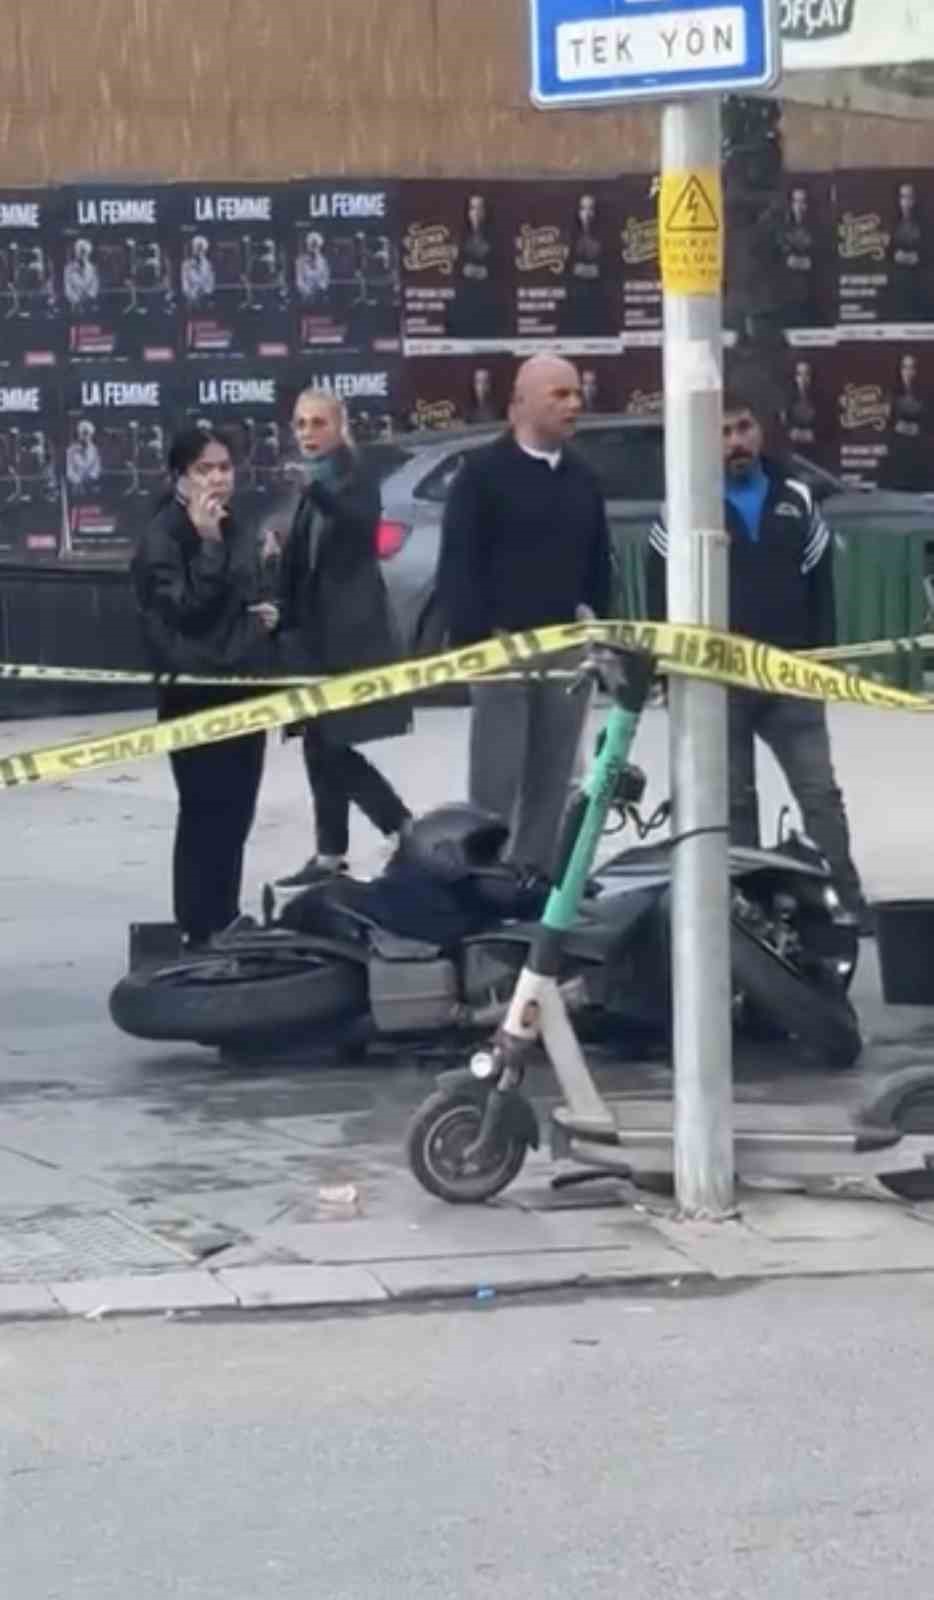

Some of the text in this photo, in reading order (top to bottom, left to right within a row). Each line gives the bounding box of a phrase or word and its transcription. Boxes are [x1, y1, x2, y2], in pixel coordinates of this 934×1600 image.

[568, 20, 735, 66] TEK YÖN
[77, 199, 156, 224] LA FEMME
[195, 196, 272, 221] LA FEMME
[310, 192, 385, 217] LA FEMME
[82, 382, 160, 407] LA FEMME
[200, 379, 275, 404] LA FEMME
[334, 372, 389, 399] FEMME
